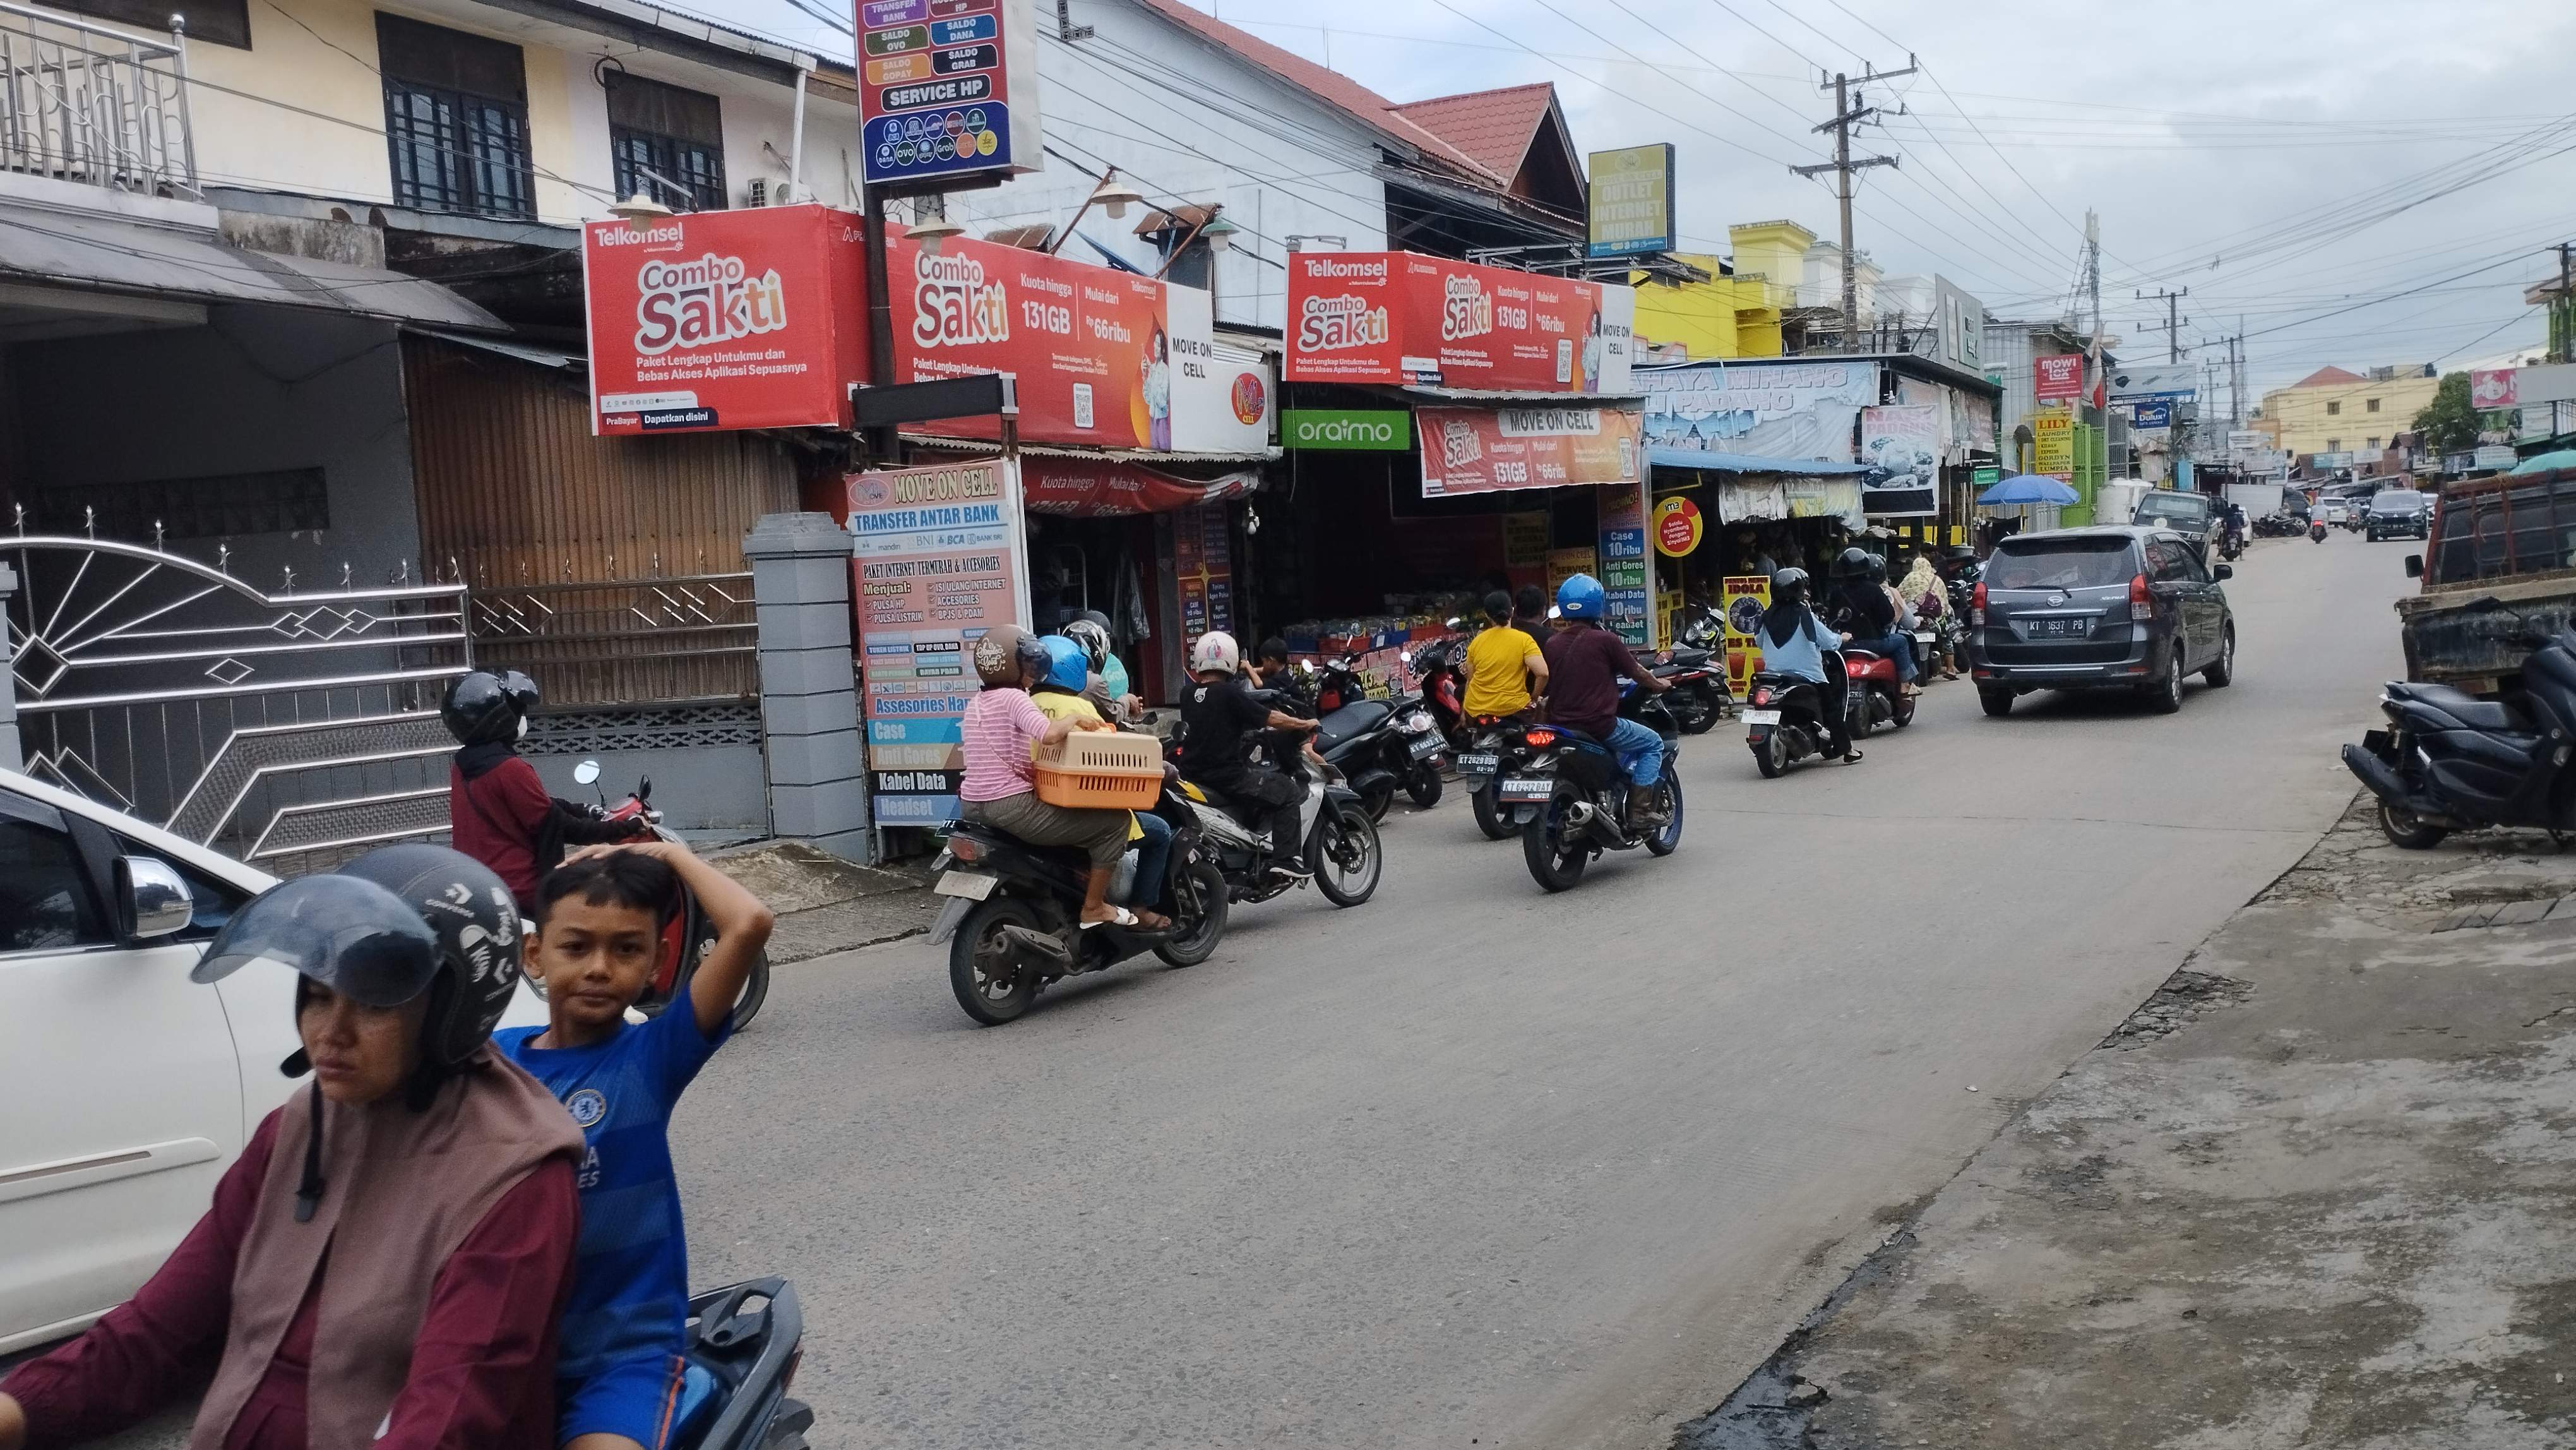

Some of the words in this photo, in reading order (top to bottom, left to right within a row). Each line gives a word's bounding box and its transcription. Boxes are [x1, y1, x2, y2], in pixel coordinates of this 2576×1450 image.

[871, 0, 917, 13] TRANSFER
[955, 3, 967, 12] HP
[883, 11, 907, 23] BANK
[947, 19, 976, 31] SALDO
[881, 29, 910, 41] SALDO
[950, 30, 975, 41] DANA
[887, 40, 906, 51] OVO
[948, 48, 978, 60] SALDO
[883, 59, 910, 71] SALDO
[951, 59, 976, 71] GRAB
[883, 69, 913, 81] GOPAY
[890, 83, 957, 107] SERVICE
[960, 79, 983, 97] HP
[897, 148, 914, 158] OVO
[937, 142, 954, 153] Grab
[1601, 181, 1654, 203] OUTLET
[1594, 200, 1661, 222] INTERNET
[595, 222, 684, 247] Telkomsel
[643, 258, 740, 291] Combo
[917, 254, 981, 282] Combo
[1304, 258, 1387, 277] Telkomsel
[1020, 273, 1045, 291] Kuota
[1046, 277, 1072, 297] hingga
[1131, 281, 1156, 296] Telkomsel
[1448, 278, 1479, 295] Combo
[1498, 285, 1512, 297] Kuota
[1512, 287, 1529, 301] hingga
[1085, 287, 1104, 301] Mulai
[1105, 291, 1119, 305] dari
[1536, 291, 1548, 303] Mulai
[1549, 292, 1558, 304] dari
[641, 275, 782, 348] Sakti
[917, 283, 1006, 340] Sakti
[1306, 297, 1363, 313] Combo
[1022, 300, 1070, 334] 131GB
[1443, 293, 1491, 336] Sakti
[1498, 305, 1527, 330] 131GB
[1301, 309, 1385, 347] Sakti
[1603, 324, 1620, 337] MOVE
[1622, 326, 1630, 338] ON
[1173, 337, 1198, 356] MOVE
[1200, 342, 1212, 359] ON
[1608, 343, 1623, 355] CELL
[636, 357, 666, 368] Paket
[667, 354, 712, 368] Lengkap
[714, 351, 763, 363] Untukmu
[765, 349, 785, 360] dan
[637, 370, 669, 382] Bebas
[671, 368, 703, 380] Akses
[705, 364, 747, 380] Aplikasi
[748, 362, 807, 377] Sepuasnya
[913, 358, 933, 369] Paket
[934, 360, 961, 378] Lengkap
[1183, 362, 1205, 378] CELL
[1727, 366, 1849, 390] MINANG
[1676, 392, 1793, 413] PADANG
[606, 417, 638, 426] PraBayar
[645, 414, 684, 424] Dapatkan
[686, 412, 708, 421] disini
[1510, 412, 1544, 432] MOVE
[1546, 410, 1563, 431] ON
[1566, 412, 1594, 430] CELL
[2039, 419, 2069, 429] LILY
[1298, 419, 1392, 441] oraimo
[1445, 422, 1469, 436] Combo
[1445, 432, 1482, 467] Sakti
[1506, 441, 1525, 454] hingga
[1493, 462, 1527, 483] 131GB
[894, 472, 936, 504] MOVE
[937, 470, 960, 500] ON
[961, 467, 998, 497] CELL
[1041, 475, 1067, 489] Kuota
[1067, 475, 1095, 491] hingga
[855, 511, 917, 532] TRANSFER
[920, 508, 960, 527] ANTAR
[964, 505, 999, 523] BANK
[917, 535, 934, 546] BNI
[947, 535, 964, 545] BCA
[1611, 532, 1633, 541] Case
[863, 564, 883, 579] PAKET
[885, 561, 917, 578] INTERNET
[917, 559, 953, 576] TERMURAH
[955, 558, 960, 572] &
[962, 556, 1000, 573] ACCESORIES
[1555, 565, 1593, 575] SERVICE
[1606, 561, 1621, 572] Anti
[1622, 560, 1643, 570] Gores
[863, 581, 911, 597] Menjual:
[936, 584, 945, 592] ISI
[947, 582, 970, 592] ULANG
[972, 579, 1006, 590] INTERNET
[1727, 584, 1765, 594] IDOLA
[937, 594, 980, 607] ACCESORIES
[1606, 591, 1626, 600] Kabel
[1628, 590, 1645, 599] Data
[873, 601, 895, 611] PULSA
[896, 599, 905, 609] HP
[874, 613, 897, 623] PULSA
[898, 612, 923, 622] LISTRIK
[938, 609, 956, 620] BPJS
[957, 609, 963, 619] &
[964, 608, 984, 618] PDAM
[2030, 621, 2040, 631] KT
[2048, 621, 2065, 630] 1637
[2073, 620, 2083, 630] PB
[1727, 638, 1743, 648] ES
[876, 698, 945, 714] Assesories
[875, 722, 906, 740] Case
[877, 748, 902, 765] Anti
[904, 746, 941, 765] Gores
[879, 772, 914, 790] Kabel
[917, 772, 946, 790] Data
[1505, 782, 1515, 792] KT
[881, 798, 933, 816] Headset
